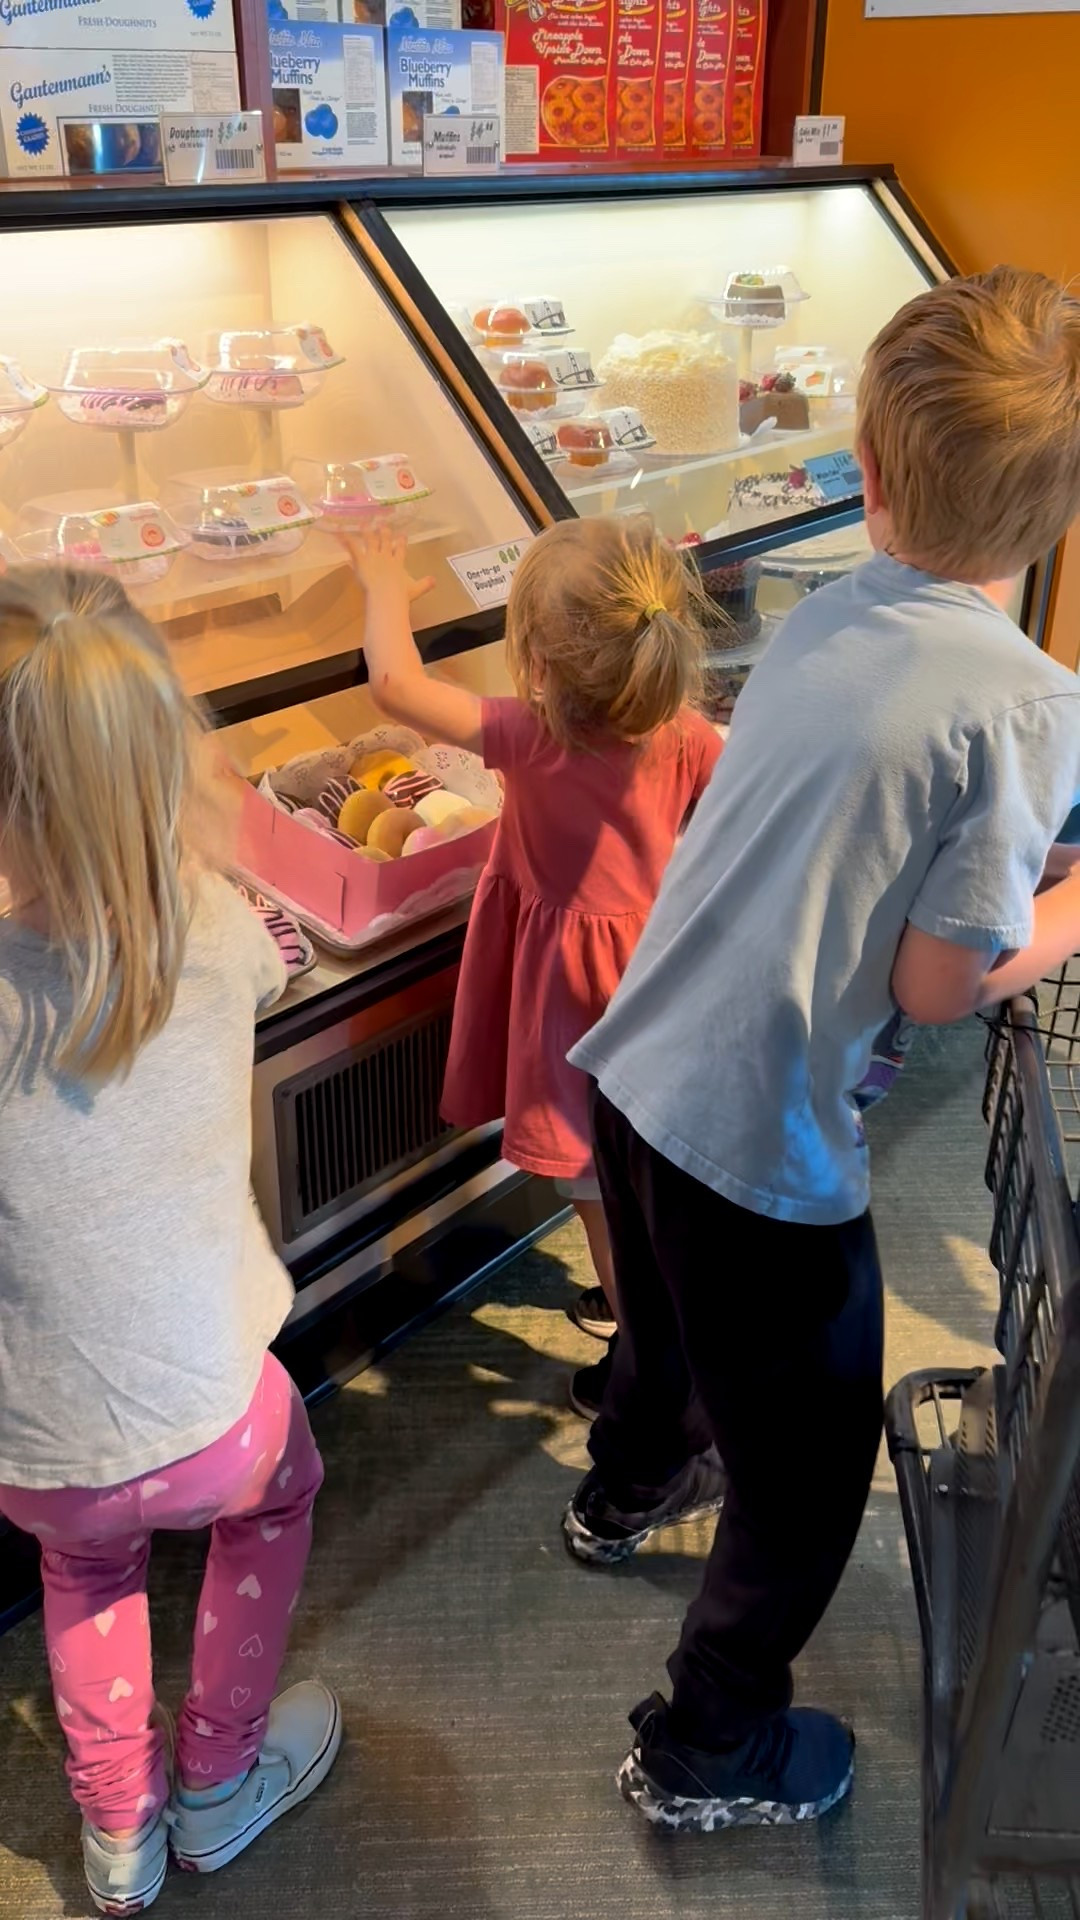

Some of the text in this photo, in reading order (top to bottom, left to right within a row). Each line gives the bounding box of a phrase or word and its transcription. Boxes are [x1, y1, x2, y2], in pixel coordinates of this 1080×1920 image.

[77, 15, 103, 27] FRESH
[269, 51, 321, 74] lueberry
[400, 58, 452, 78] Blueberry
[408, 73, 445, 88] Muffins
[88, 103, 113, 113] FRESH
